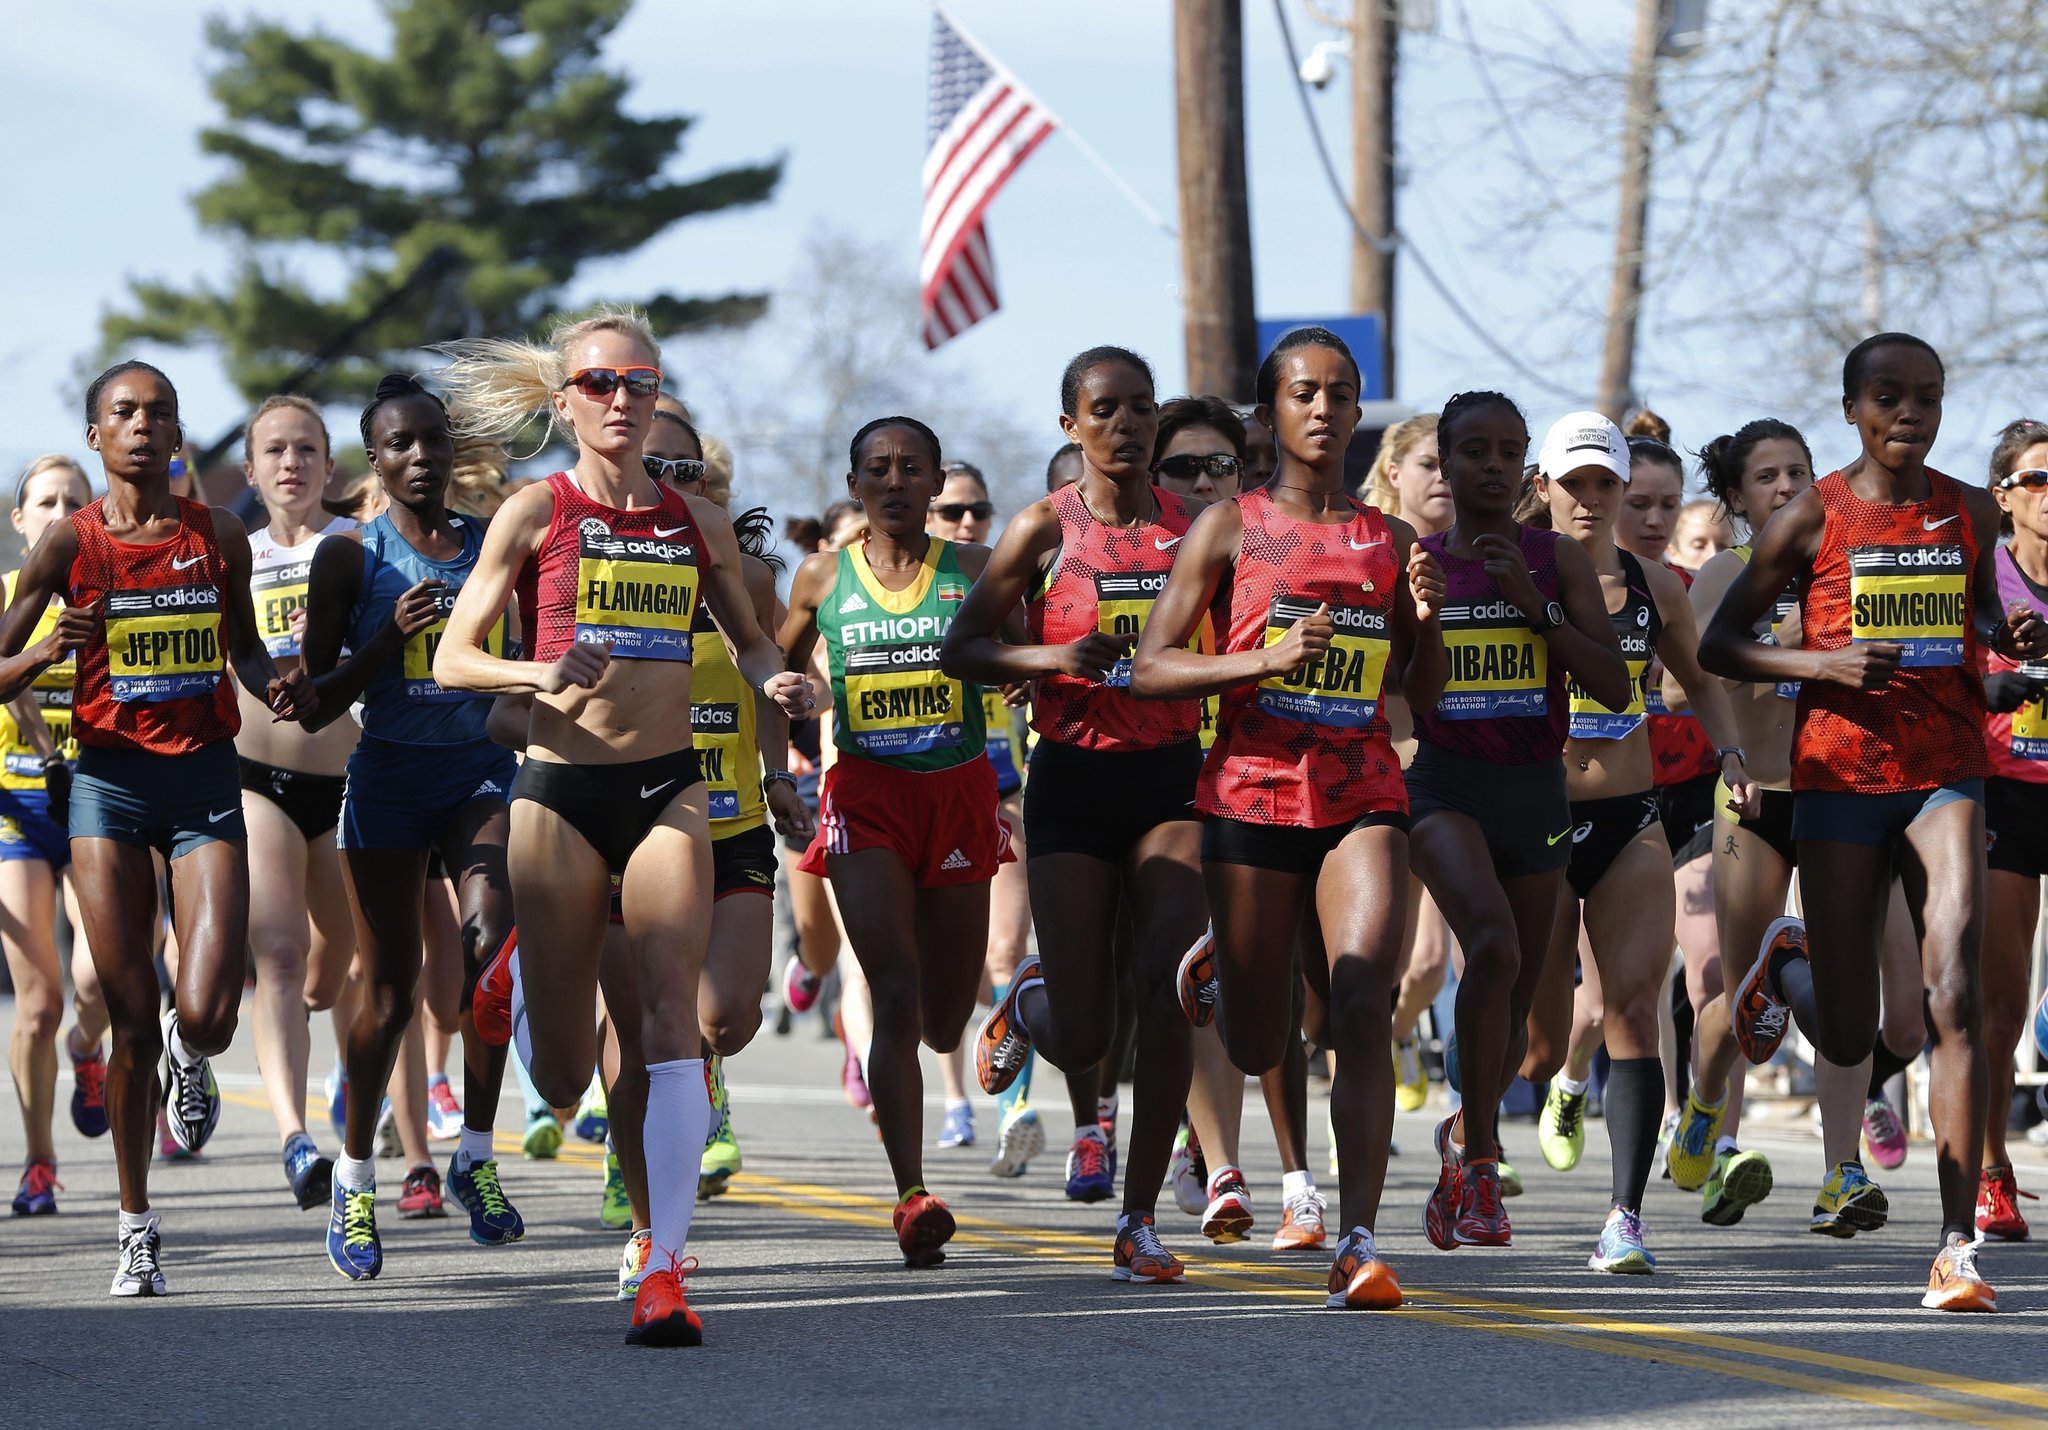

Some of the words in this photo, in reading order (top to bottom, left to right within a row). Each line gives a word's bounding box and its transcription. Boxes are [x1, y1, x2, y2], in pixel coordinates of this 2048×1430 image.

[252, 548, 274, 560] YAC
[627, 541, 691, 559] adidas
[1898, 548, 1962, 566] adidas
[280, 561, 311, 580] adi
[155, 588, 217, 608] adidas
[587, 580, 691, 616] FLANAGAN
[615, 631, 641, 639] BOSTON
[122, 627, 216, 667] JEPTOO
[1620, 635, 1646, 652] das
[145, 679, 169, 687] BOSTON
[861, 684, 952, 720] ESAYIAS
[1277, 702, 1320, 714] MARATHON
[1295, 699, 1320, 708] BOSTON
[1444, 702, 1486, 710] MARATHON
[883, 733, 908, 741] BOSTON
[869, 739, 908, 748] MARATHON
[941, 860, 972, 870] adidas
